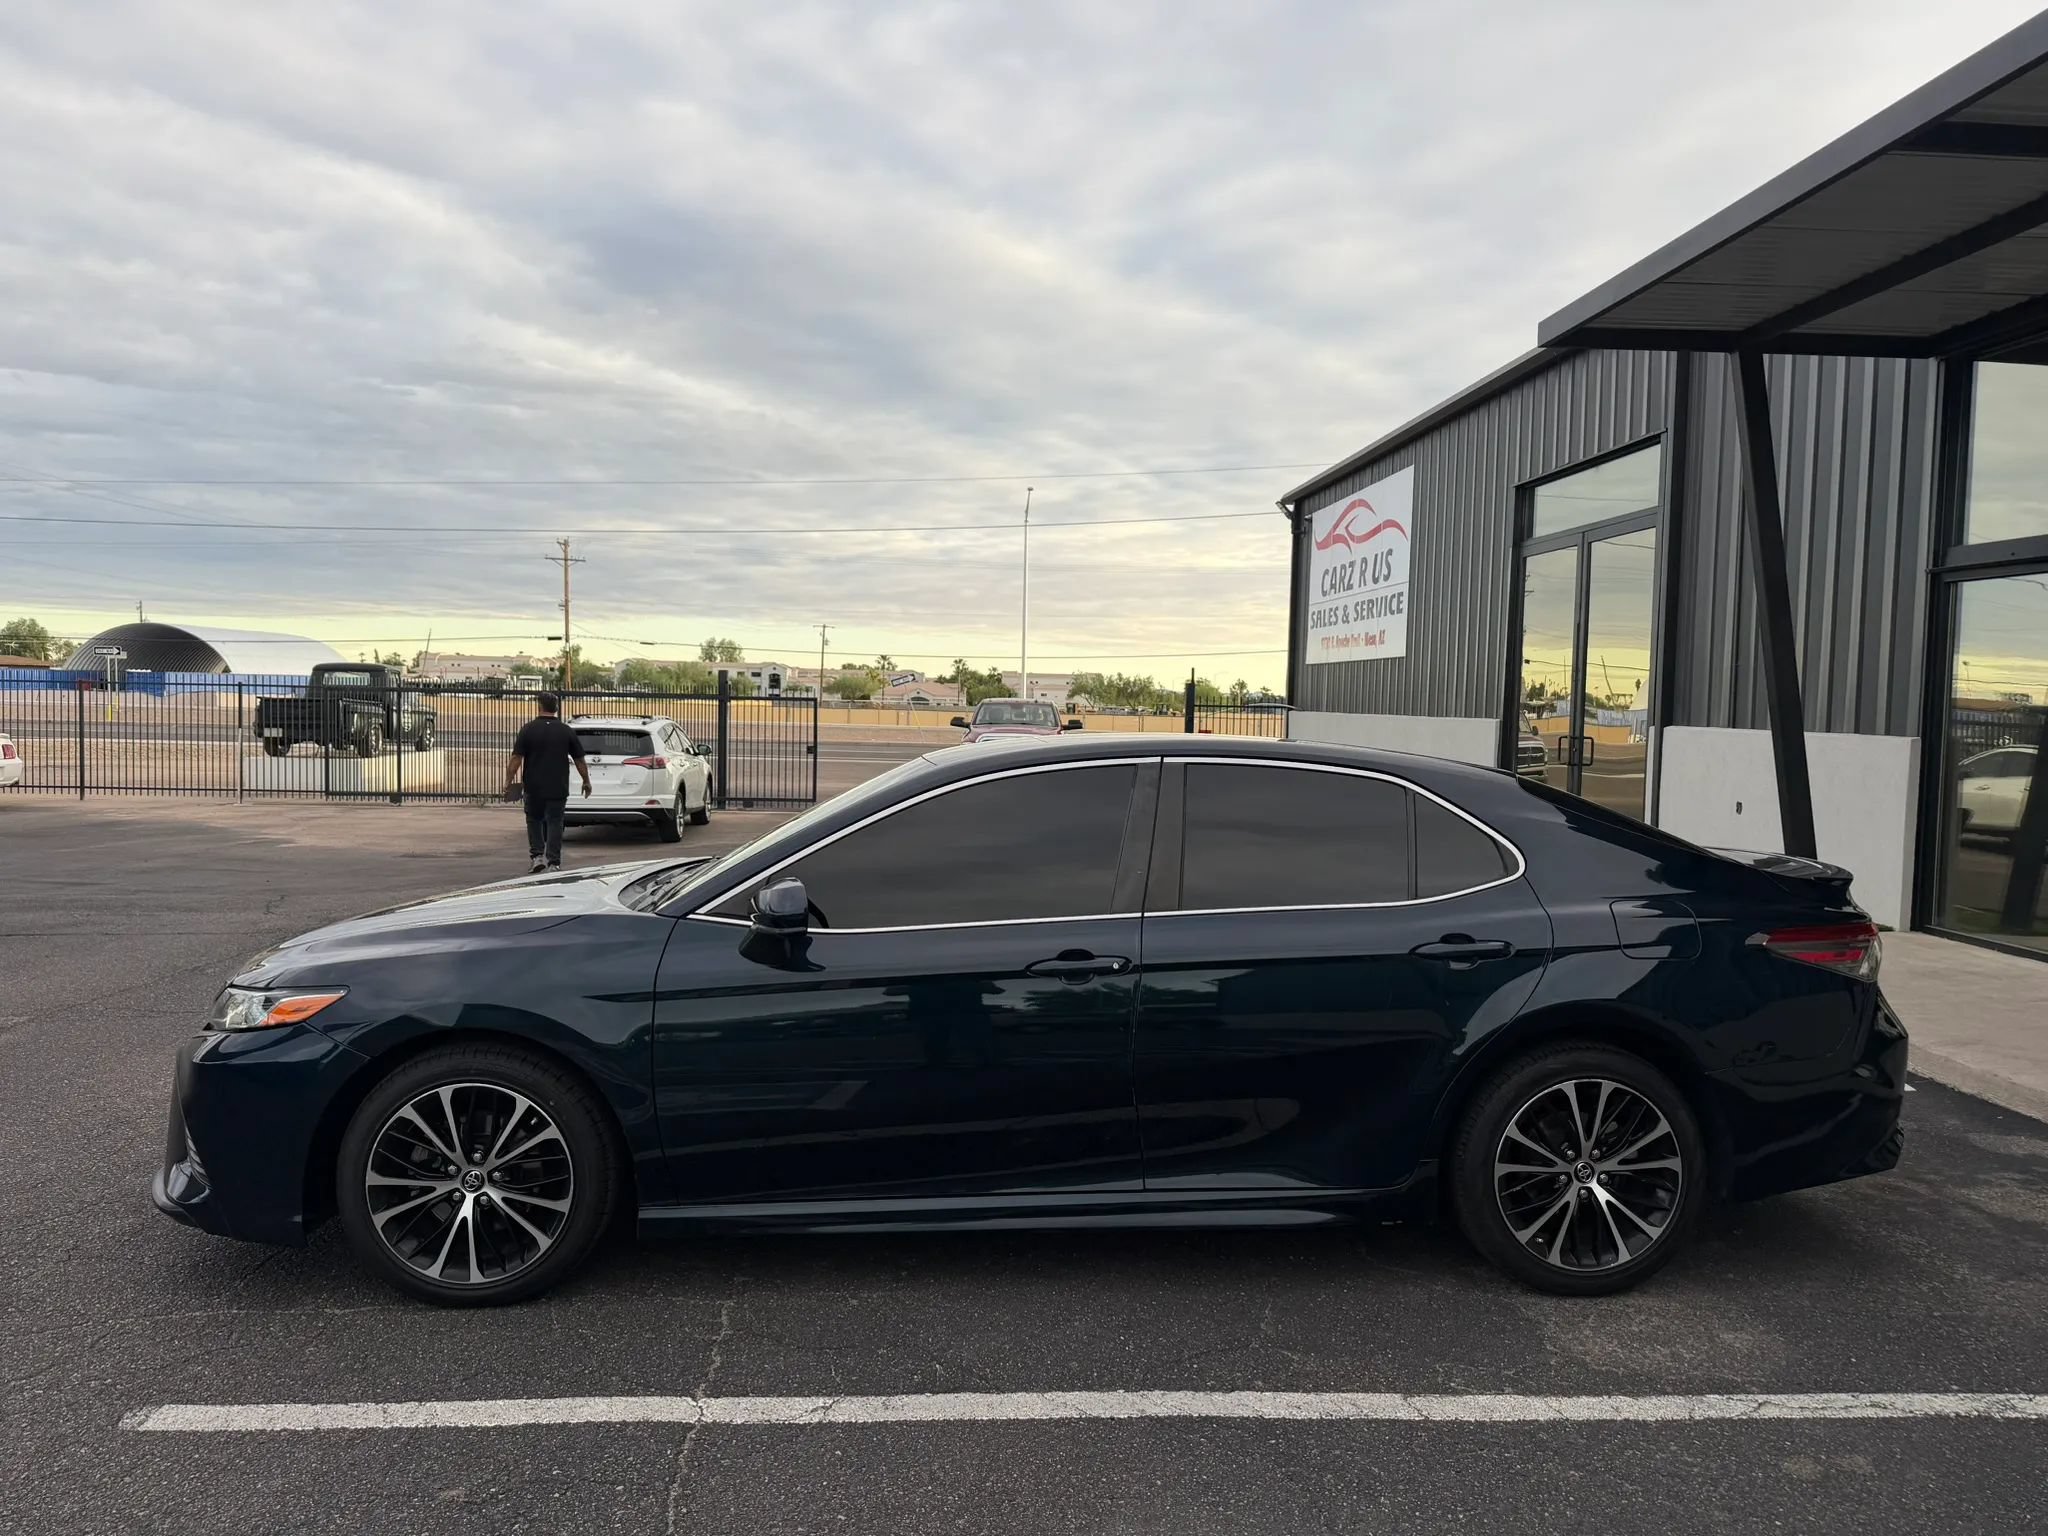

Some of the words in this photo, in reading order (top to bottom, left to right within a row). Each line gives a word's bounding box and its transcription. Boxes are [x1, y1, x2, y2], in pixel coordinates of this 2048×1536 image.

[1321, 560, 1355, 597] CARZ
[1358, 557, 1368, 587] R
[1371, 548, 1393, 584] US
[1310, 606, 1339, 630] SALES
[1341, 604, 1350, 624] &
[1353, 591, 1404, 622] SERVICE
